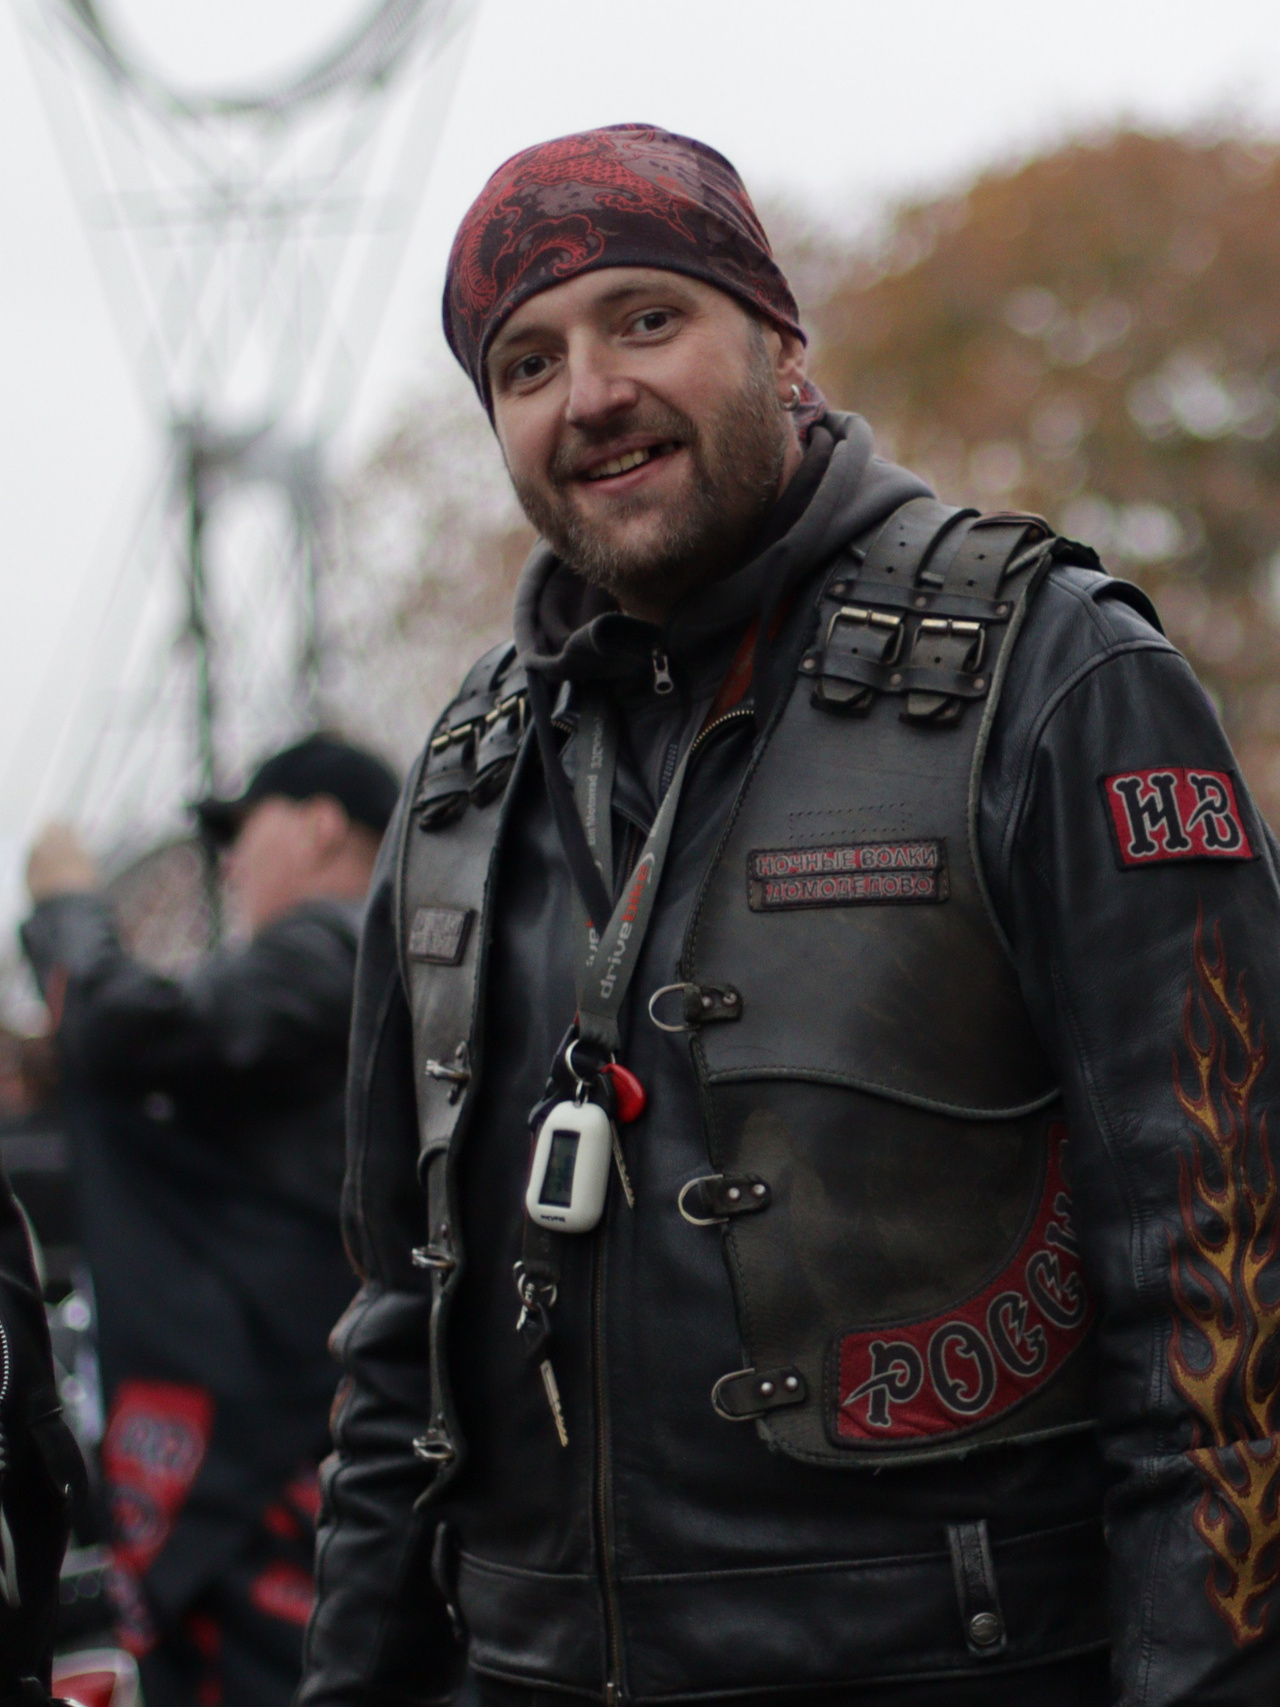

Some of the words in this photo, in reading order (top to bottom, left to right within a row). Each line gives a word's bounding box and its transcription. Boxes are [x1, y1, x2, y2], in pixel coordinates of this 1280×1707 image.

[756, 849, 856, 876] НОЧНЫЕ
[860, 846, 938, 870] ВОЛКИ
[766, 875, 934, 902] ДОМОДЕДОВО
[600, 863, 649, 999] drivebike
[841, 1138, 1088, 1428] РОСС
